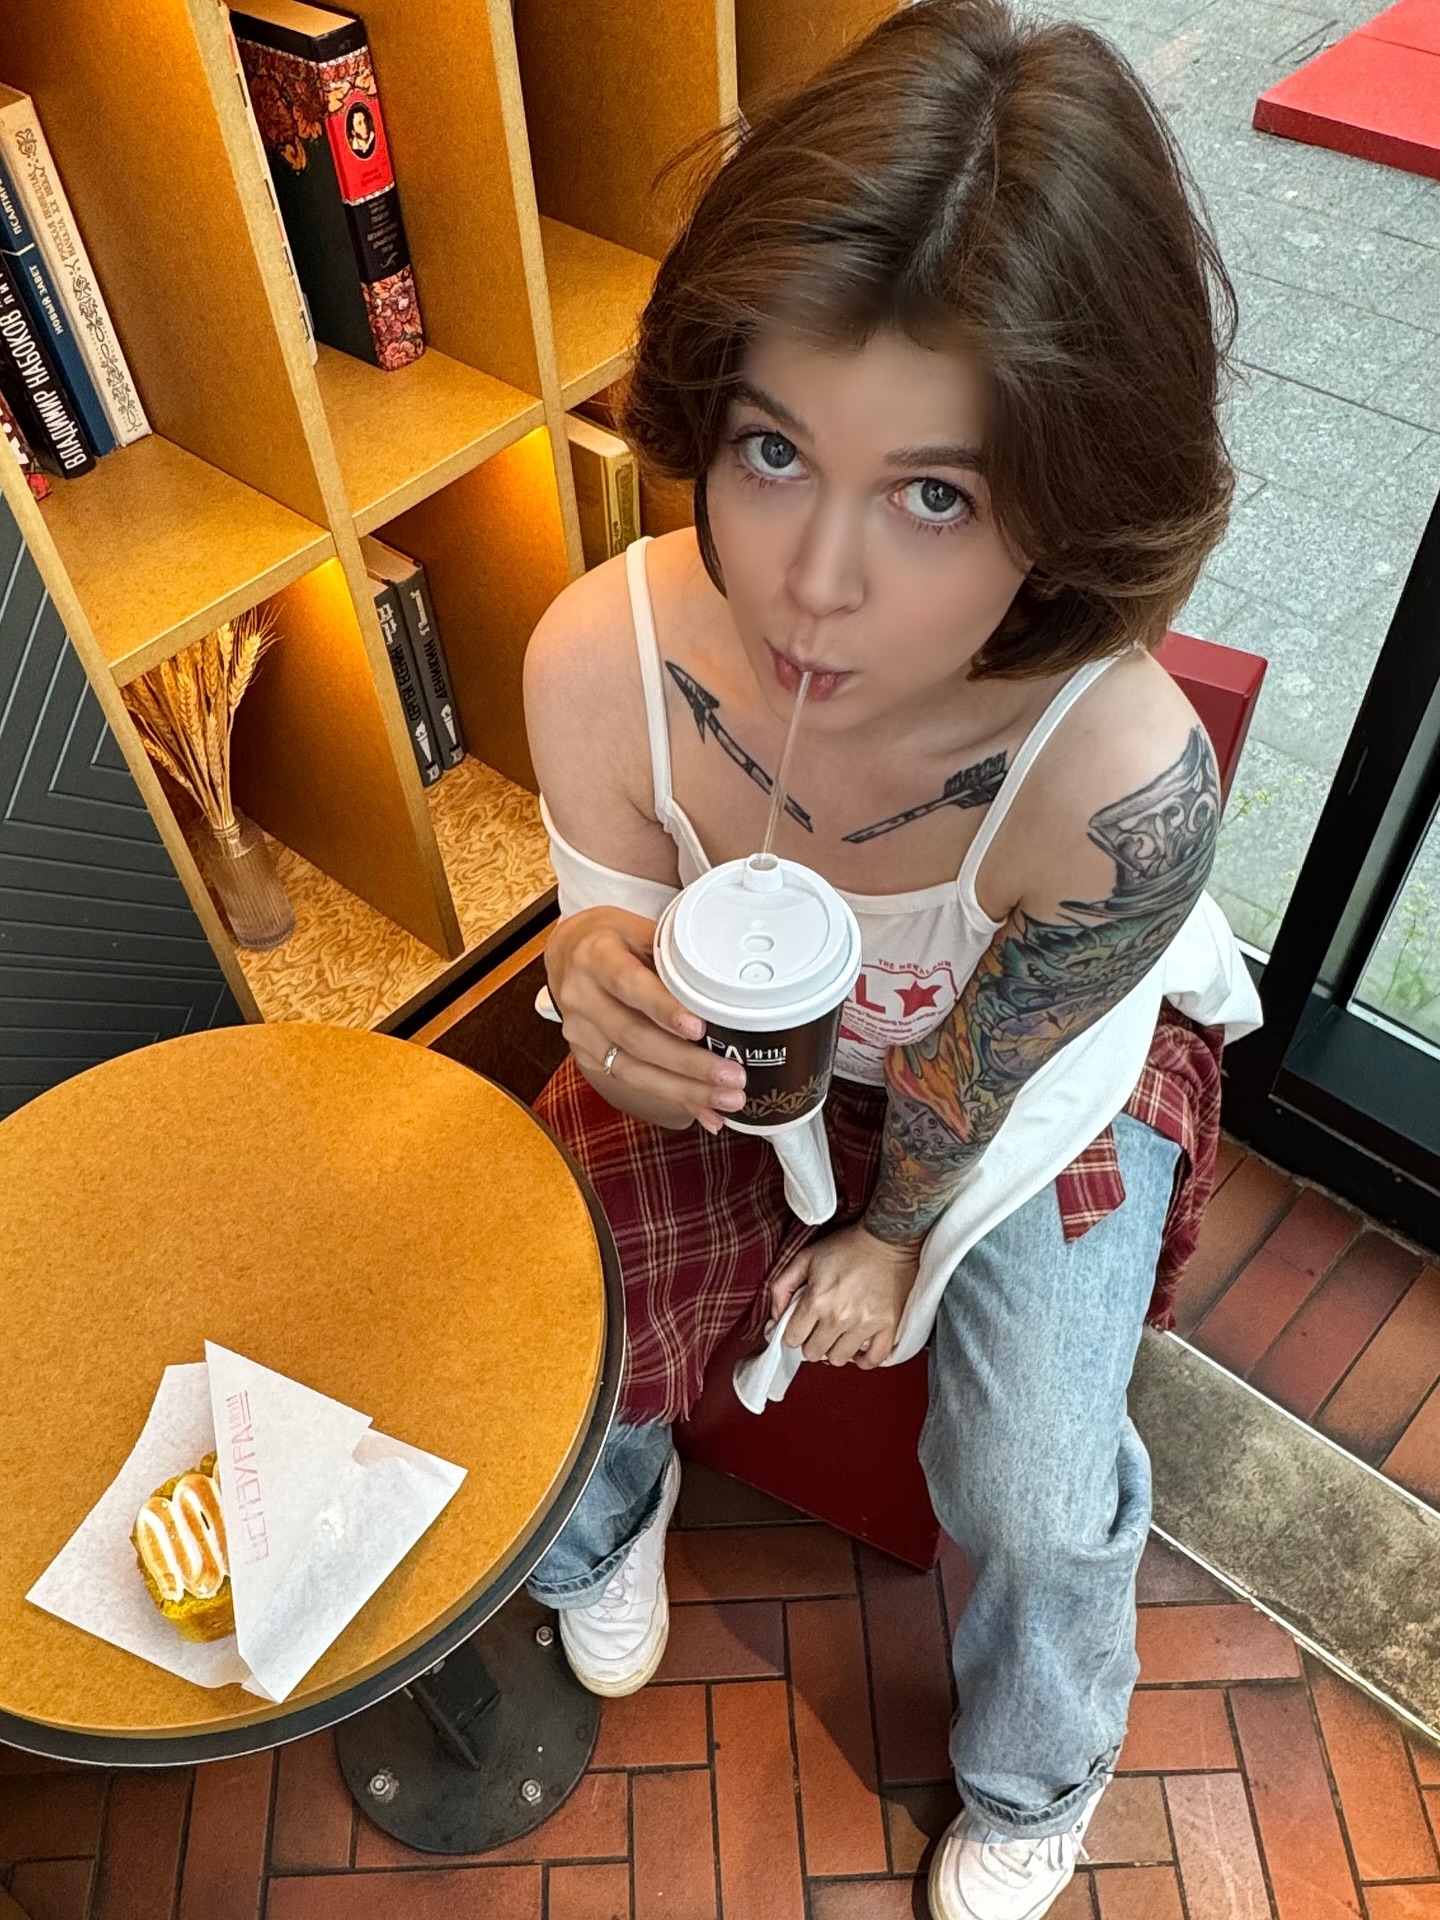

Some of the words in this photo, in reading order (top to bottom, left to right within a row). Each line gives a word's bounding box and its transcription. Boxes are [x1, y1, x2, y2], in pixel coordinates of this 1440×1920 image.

[28, 264, 49, 296] ЗАВЕТ
[41, 295, 64, 336] НОВЫЙ
[0, 308, 50, 390] НАБОКОВ
[32, 389, 88, 470] ВЛАДИМИР
[423, 638, 449, 699] ДЕНИКИН
[878, 958, 895, 970] THE
